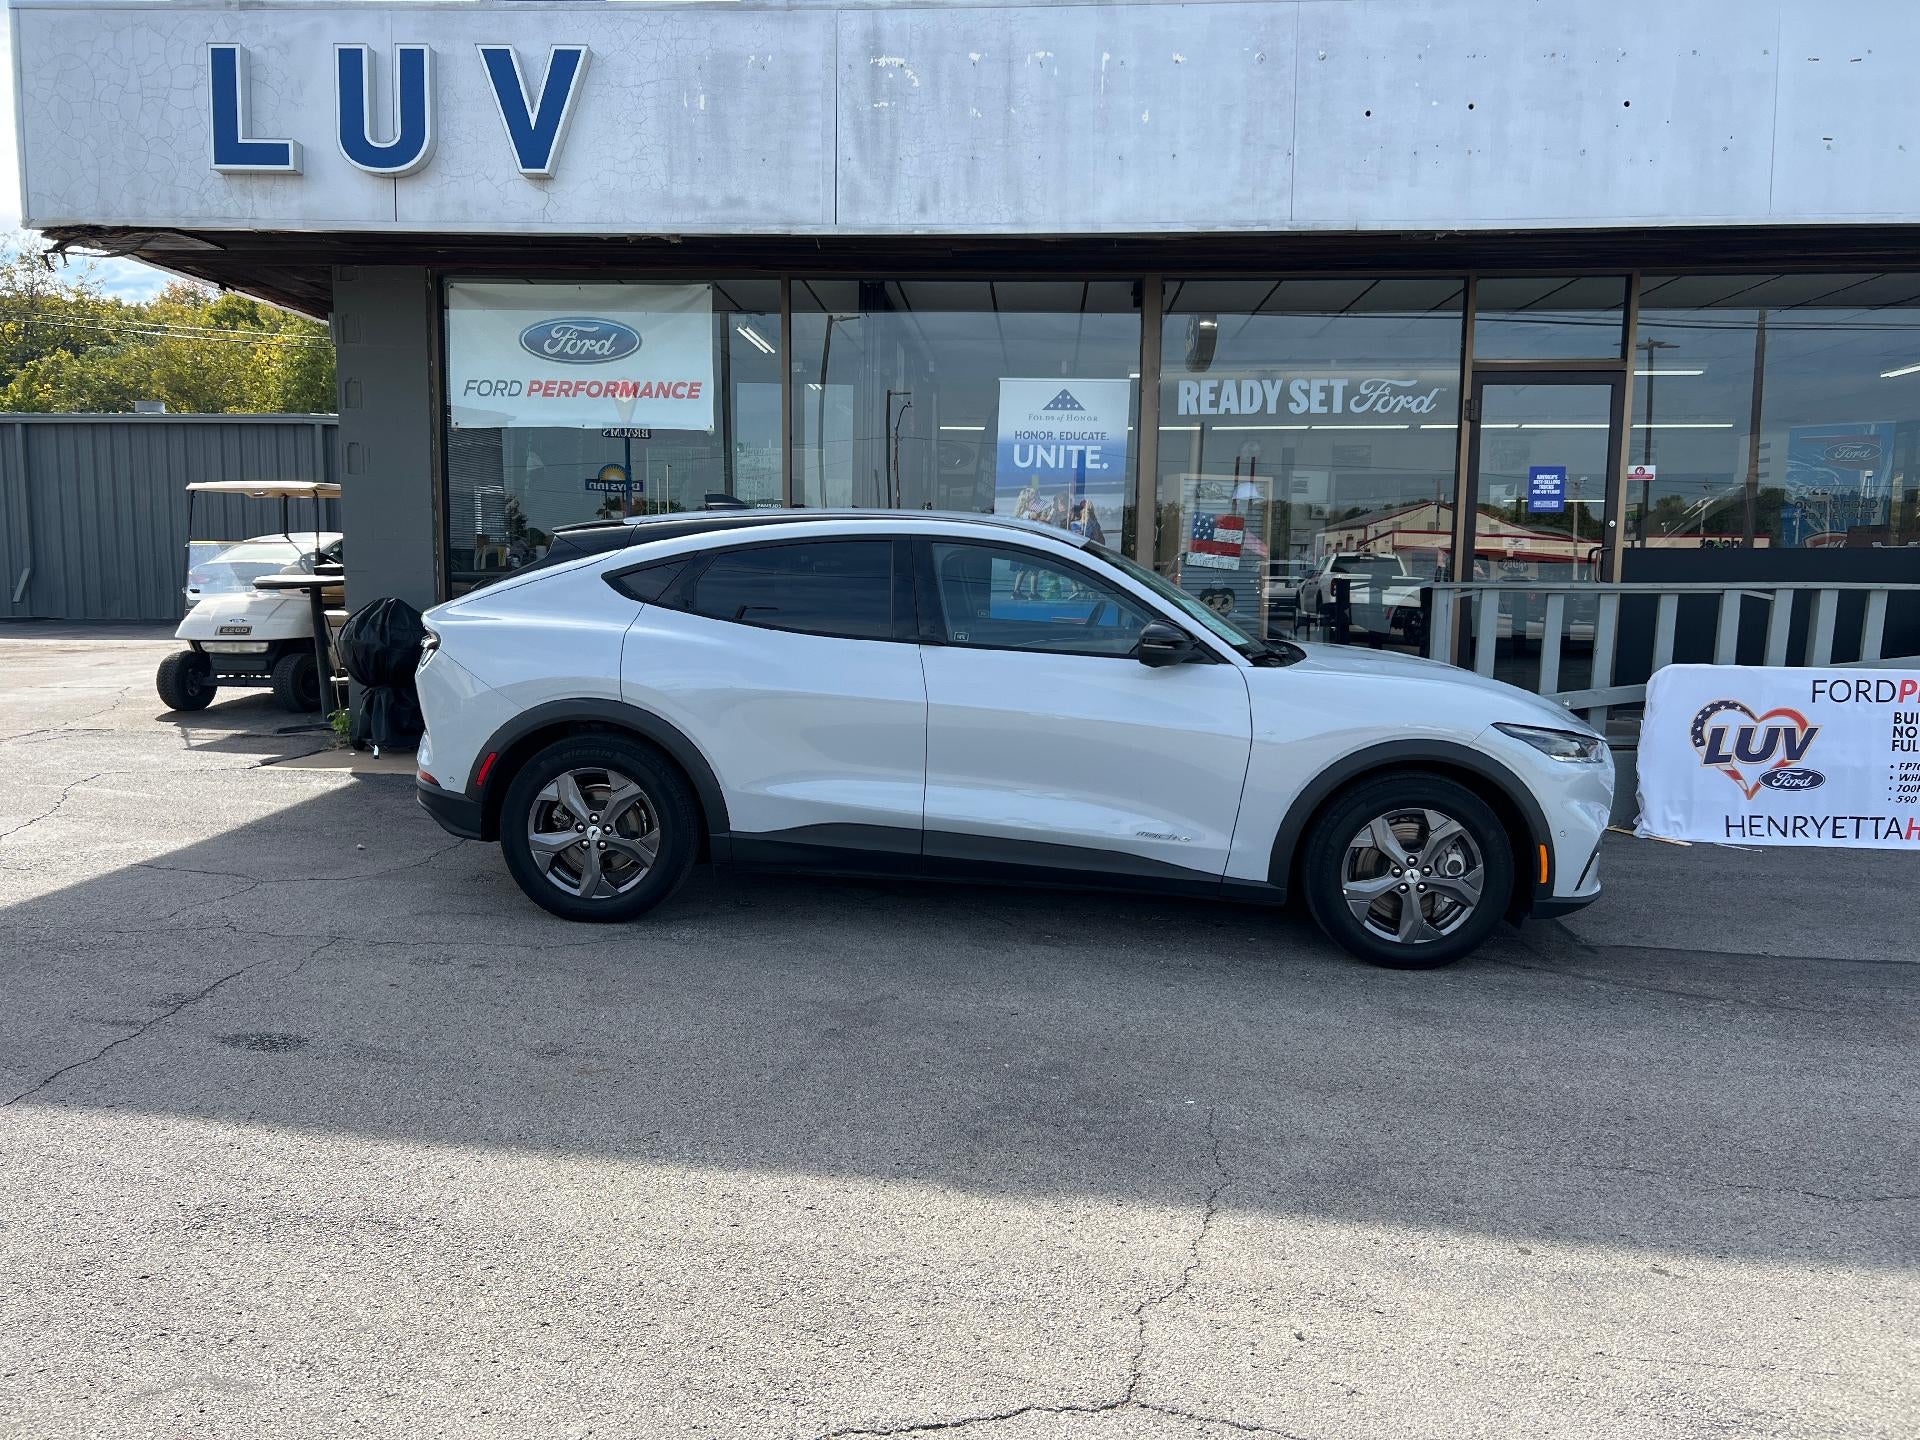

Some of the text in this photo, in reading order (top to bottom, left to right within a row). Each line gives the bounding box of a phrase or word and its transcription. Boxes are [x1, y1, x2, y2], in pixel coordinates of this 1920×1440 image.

[206, 42, 592, 179] LUV
[543, 325, 617, 356] Ford
[463, 379, 703, 400] FORD PERFORMANCE
[1177, 378, 1439, 416] READY SET Ford
[1056, 413, 1066, 423] of
[1014, 430, 1110, 441] HONOR. EDUCATE.
[1013, 444, 1110, 470] UNITE.
[1834, 445, 1871, 459] Ford
[1795, 501, 1879, 509] ON THE ROAD
[1819, 511, 1838, 520] THE
[1841, 511, 1878, 520] COURT
[1811, 679, 1920, 703] FORDP
[1892, 725, 1918, 739] NO
[1701, 724, 1822, 768] LUV
[1771, 770, 1812, 788] Ford
[1895, 795, 1918, 804] 590
